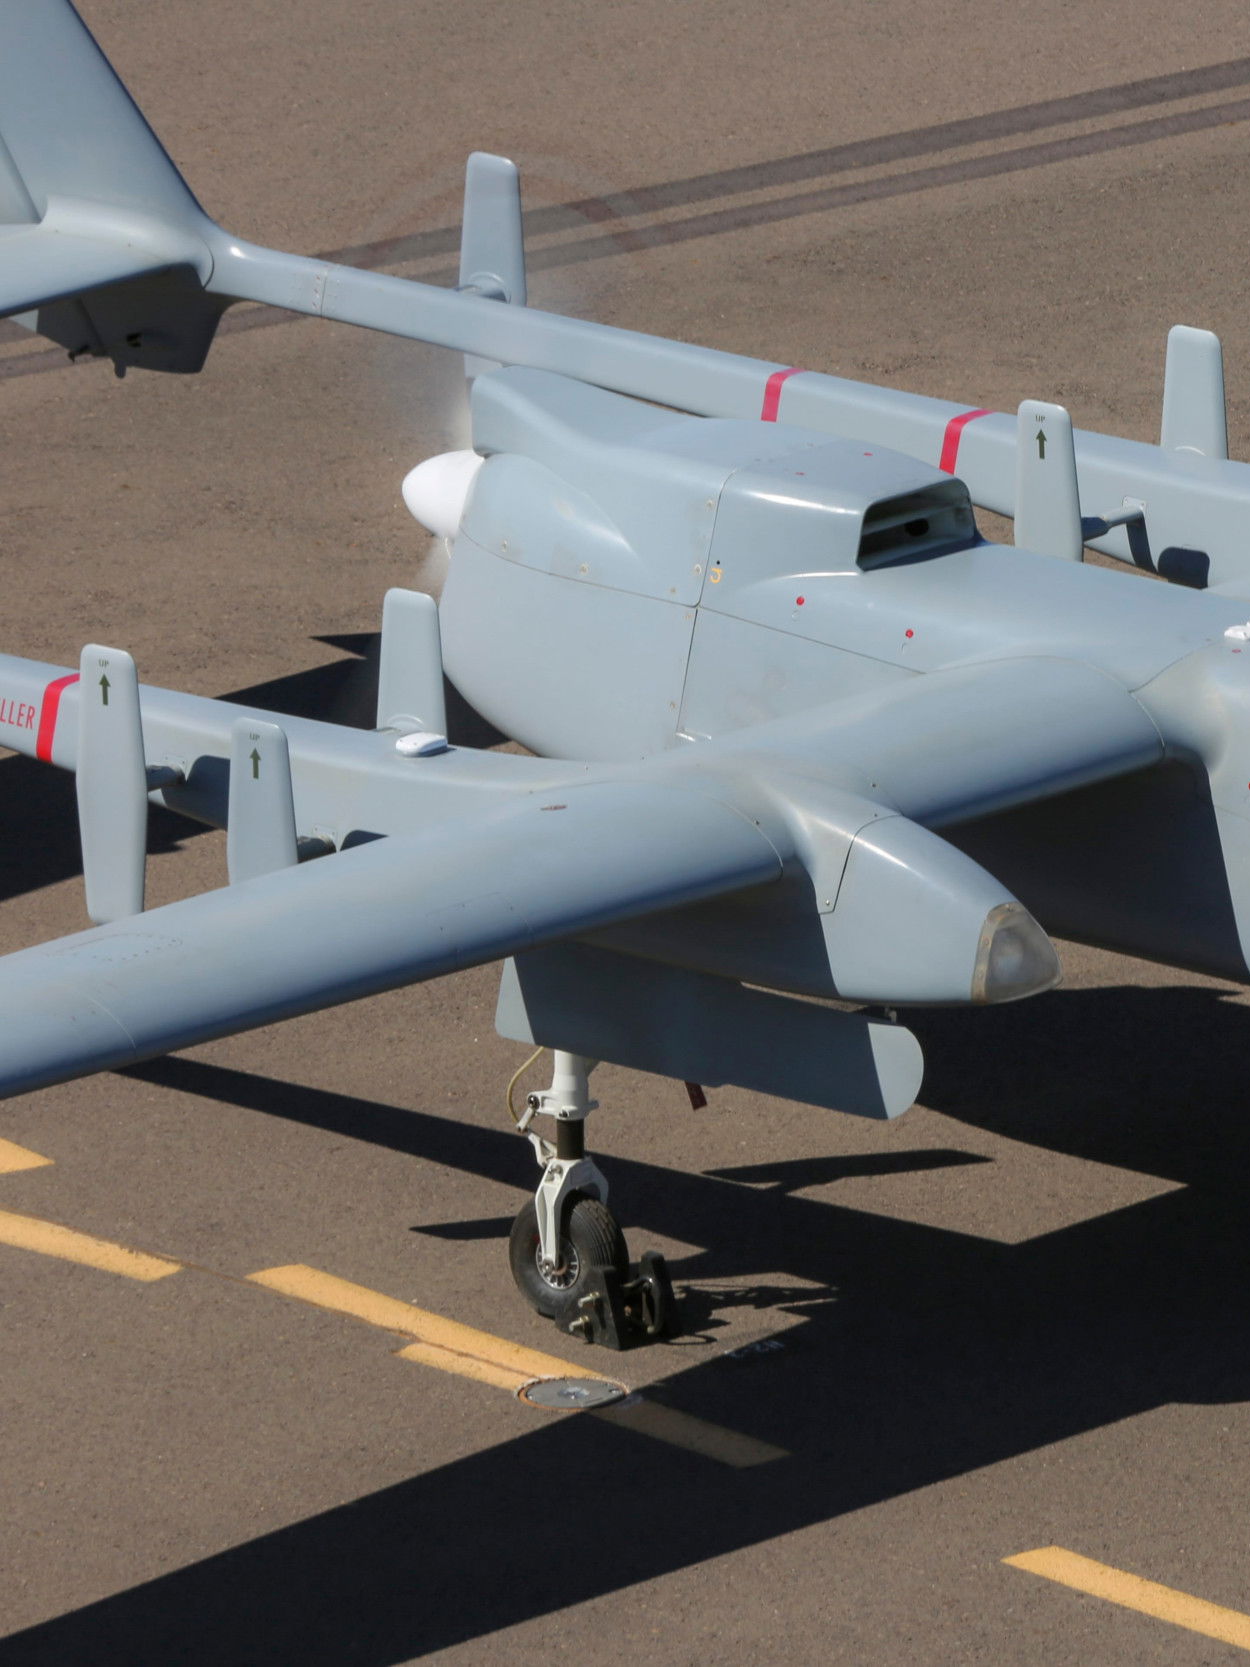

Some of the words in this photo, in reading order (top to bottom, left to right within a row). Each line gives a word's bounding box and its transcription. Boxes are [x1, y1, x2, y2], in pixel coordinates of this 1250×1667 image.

[1035, 414, 1046, 423] UP
[98, 658, 109, 668] UP
[249, 731, 260, 741] UP
